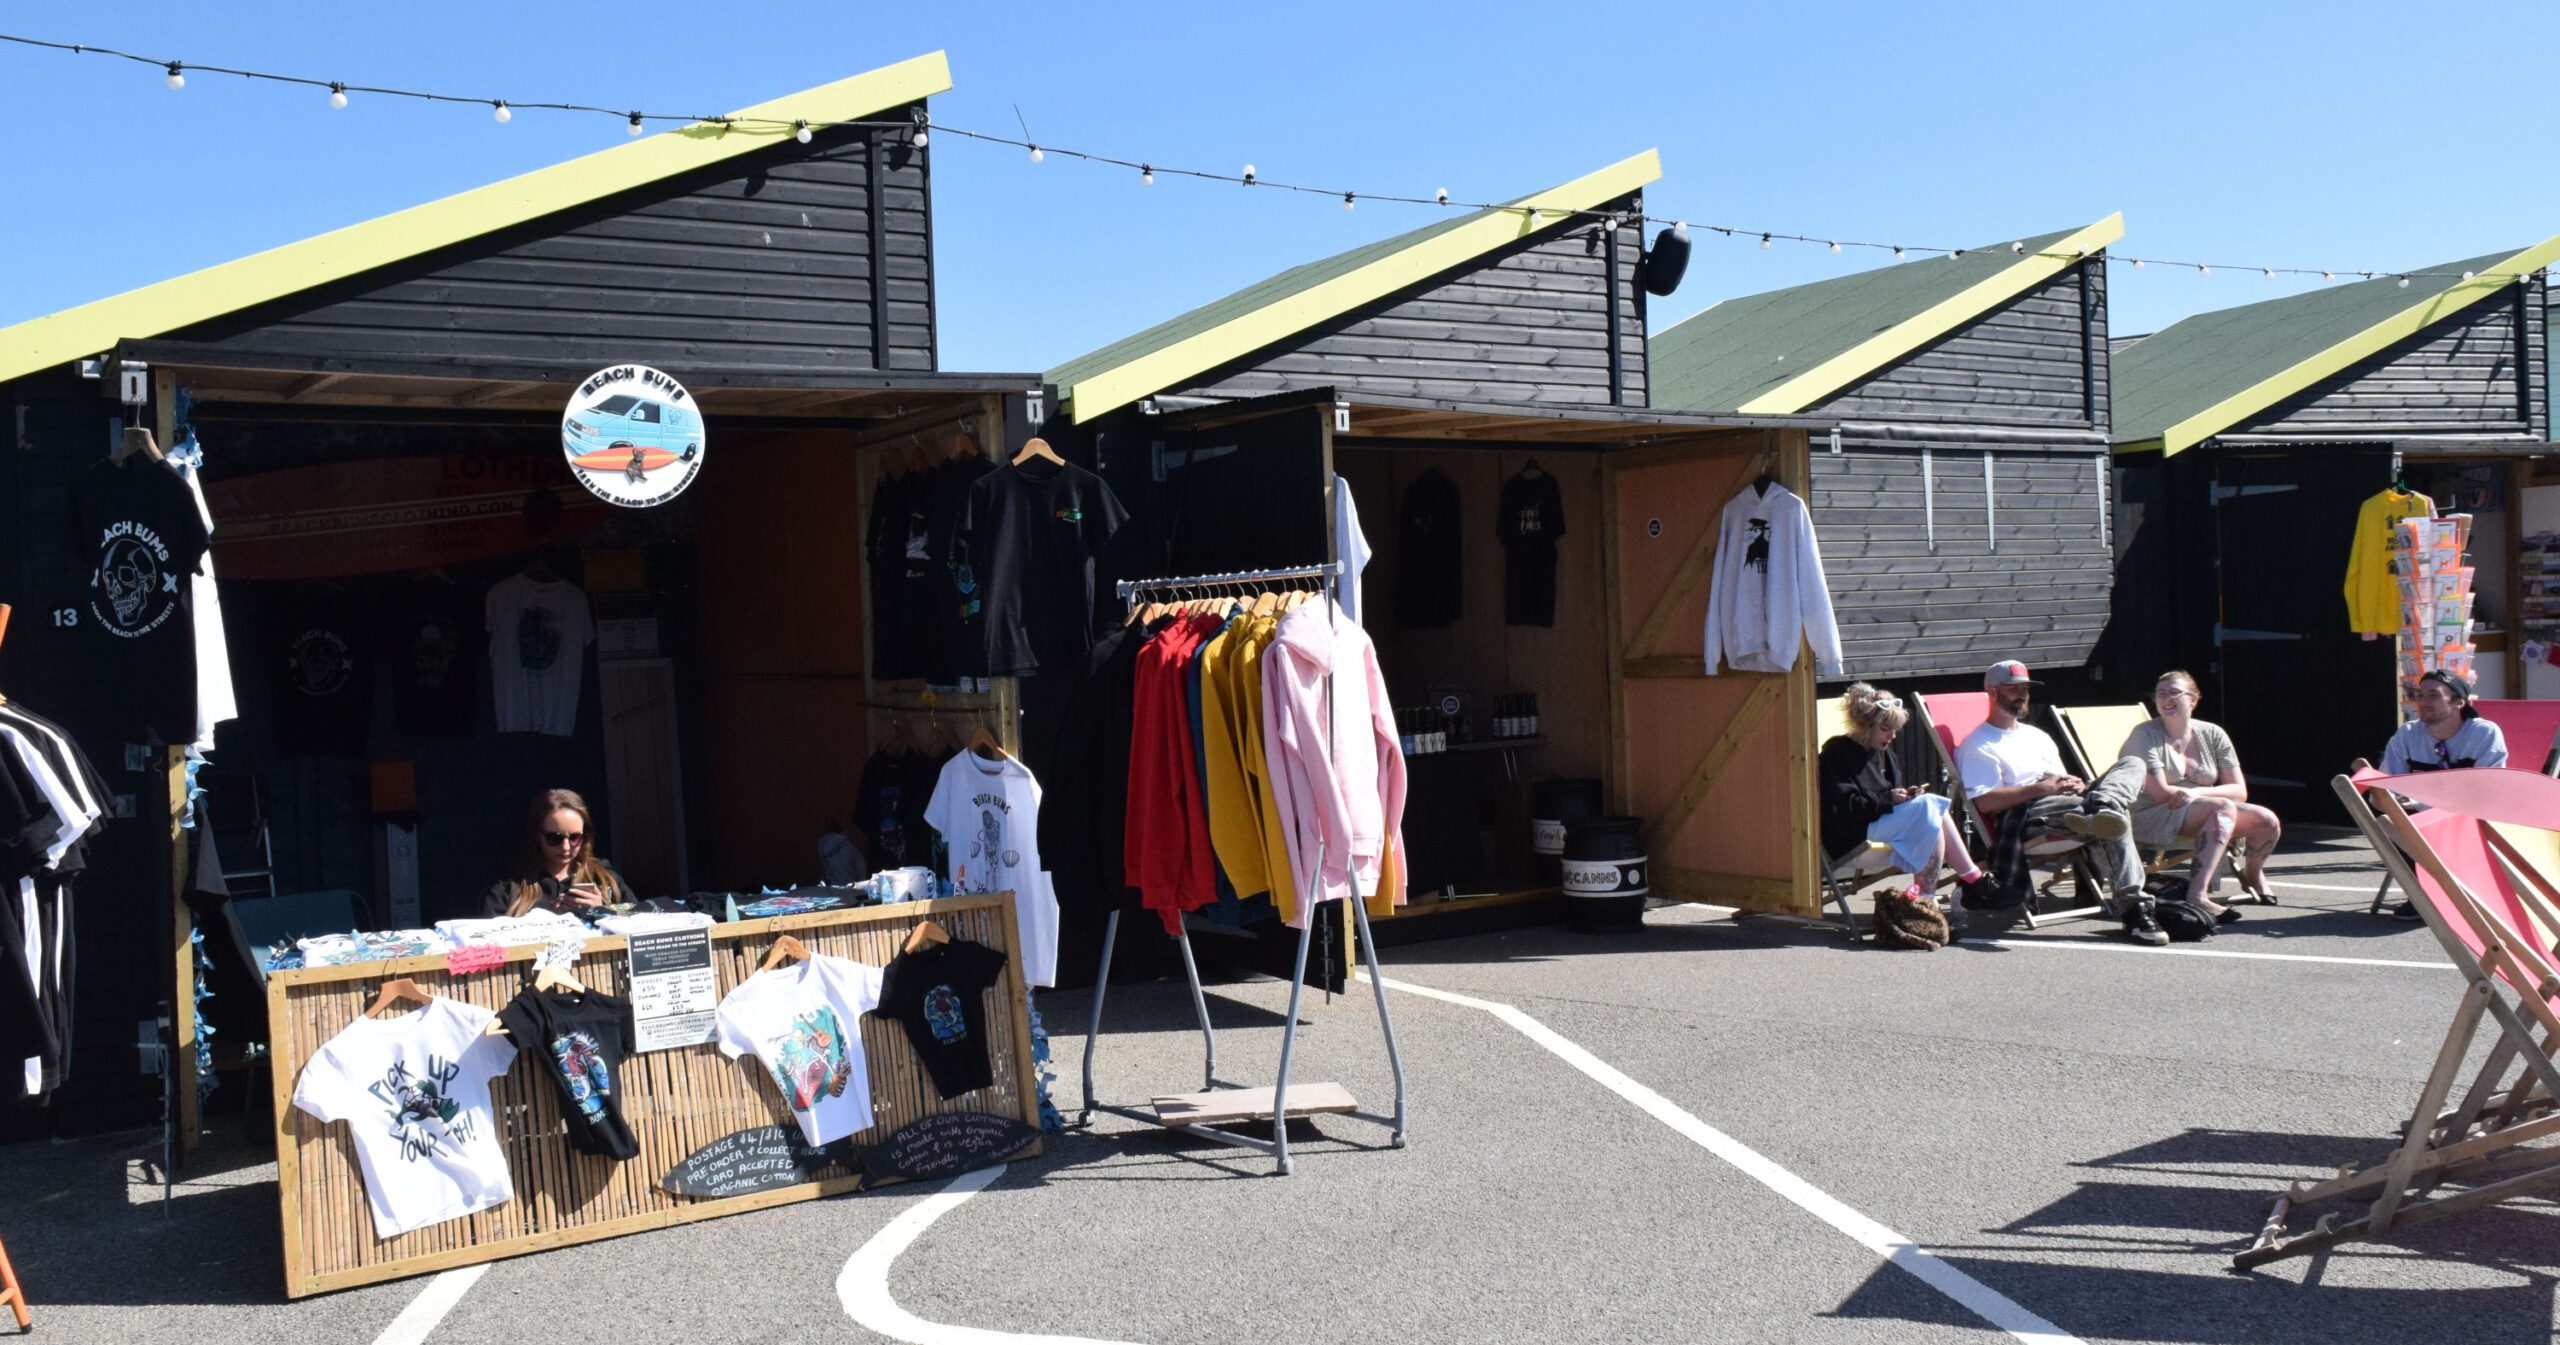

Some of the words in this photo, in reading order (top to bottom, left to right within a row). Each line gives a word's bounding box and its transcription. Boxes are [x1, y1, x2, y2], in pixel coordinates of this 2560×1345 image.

[583, 367, 635, 396] BEACH
[644, 370, 685, 401] BUMS
[576, 469, 595, 489] FROM
[596, 487, 611, 501] THE
[613, 496, 644, 507] BEACH
[645, 496, 657, 506] TO
[657, 491, 673, 502] THE
[673, 461, 700, 493] STREETS
[134, 523, 169, 562] BUMS
[53, 608, 78, 627] 13
[112, 627, 133, 639] BEACH
[151, 601, 175, 630] STREETS
[972, 793, 992, 808] BEACH
[993, 795, 1011, 815] BUMS
[634, 939, 655, 947] BEACH
[674, 933, 706, 942] CLOTHING
[367, 1060, 416, 1106] PICK
[428, 1054, 460, 1095] UP
[389, 1126, 448, 1163] YOUR
[896, 1128, 920, 1144] ALL
[920, 1120, 932, 1131] OF
[936, 1115, 960, 1125] OUR
[965, 1114, 1012, 1128] CLOTHING
[907, 1132, 935, 1153] made
[940, 1125, 962, 1137] with
[687, 1137, 736, 1171] POSTAGE
[958, 1138, 994, 1153] vegan
[687, 1166, 708, 1185] PRE
[709, 1149, 744, 1171] ORDER
[757, 1145, 795, 1156] COLLECT
[800, 1146, 827, 1156] HERE
[706, 1169, 734, 1186] CARD
[739, 1158, 795, 1175] ACCEPTED
[711, 1177, 759, 1196] ORGANIC
[761, 1173, 796, 1183] COTTON
